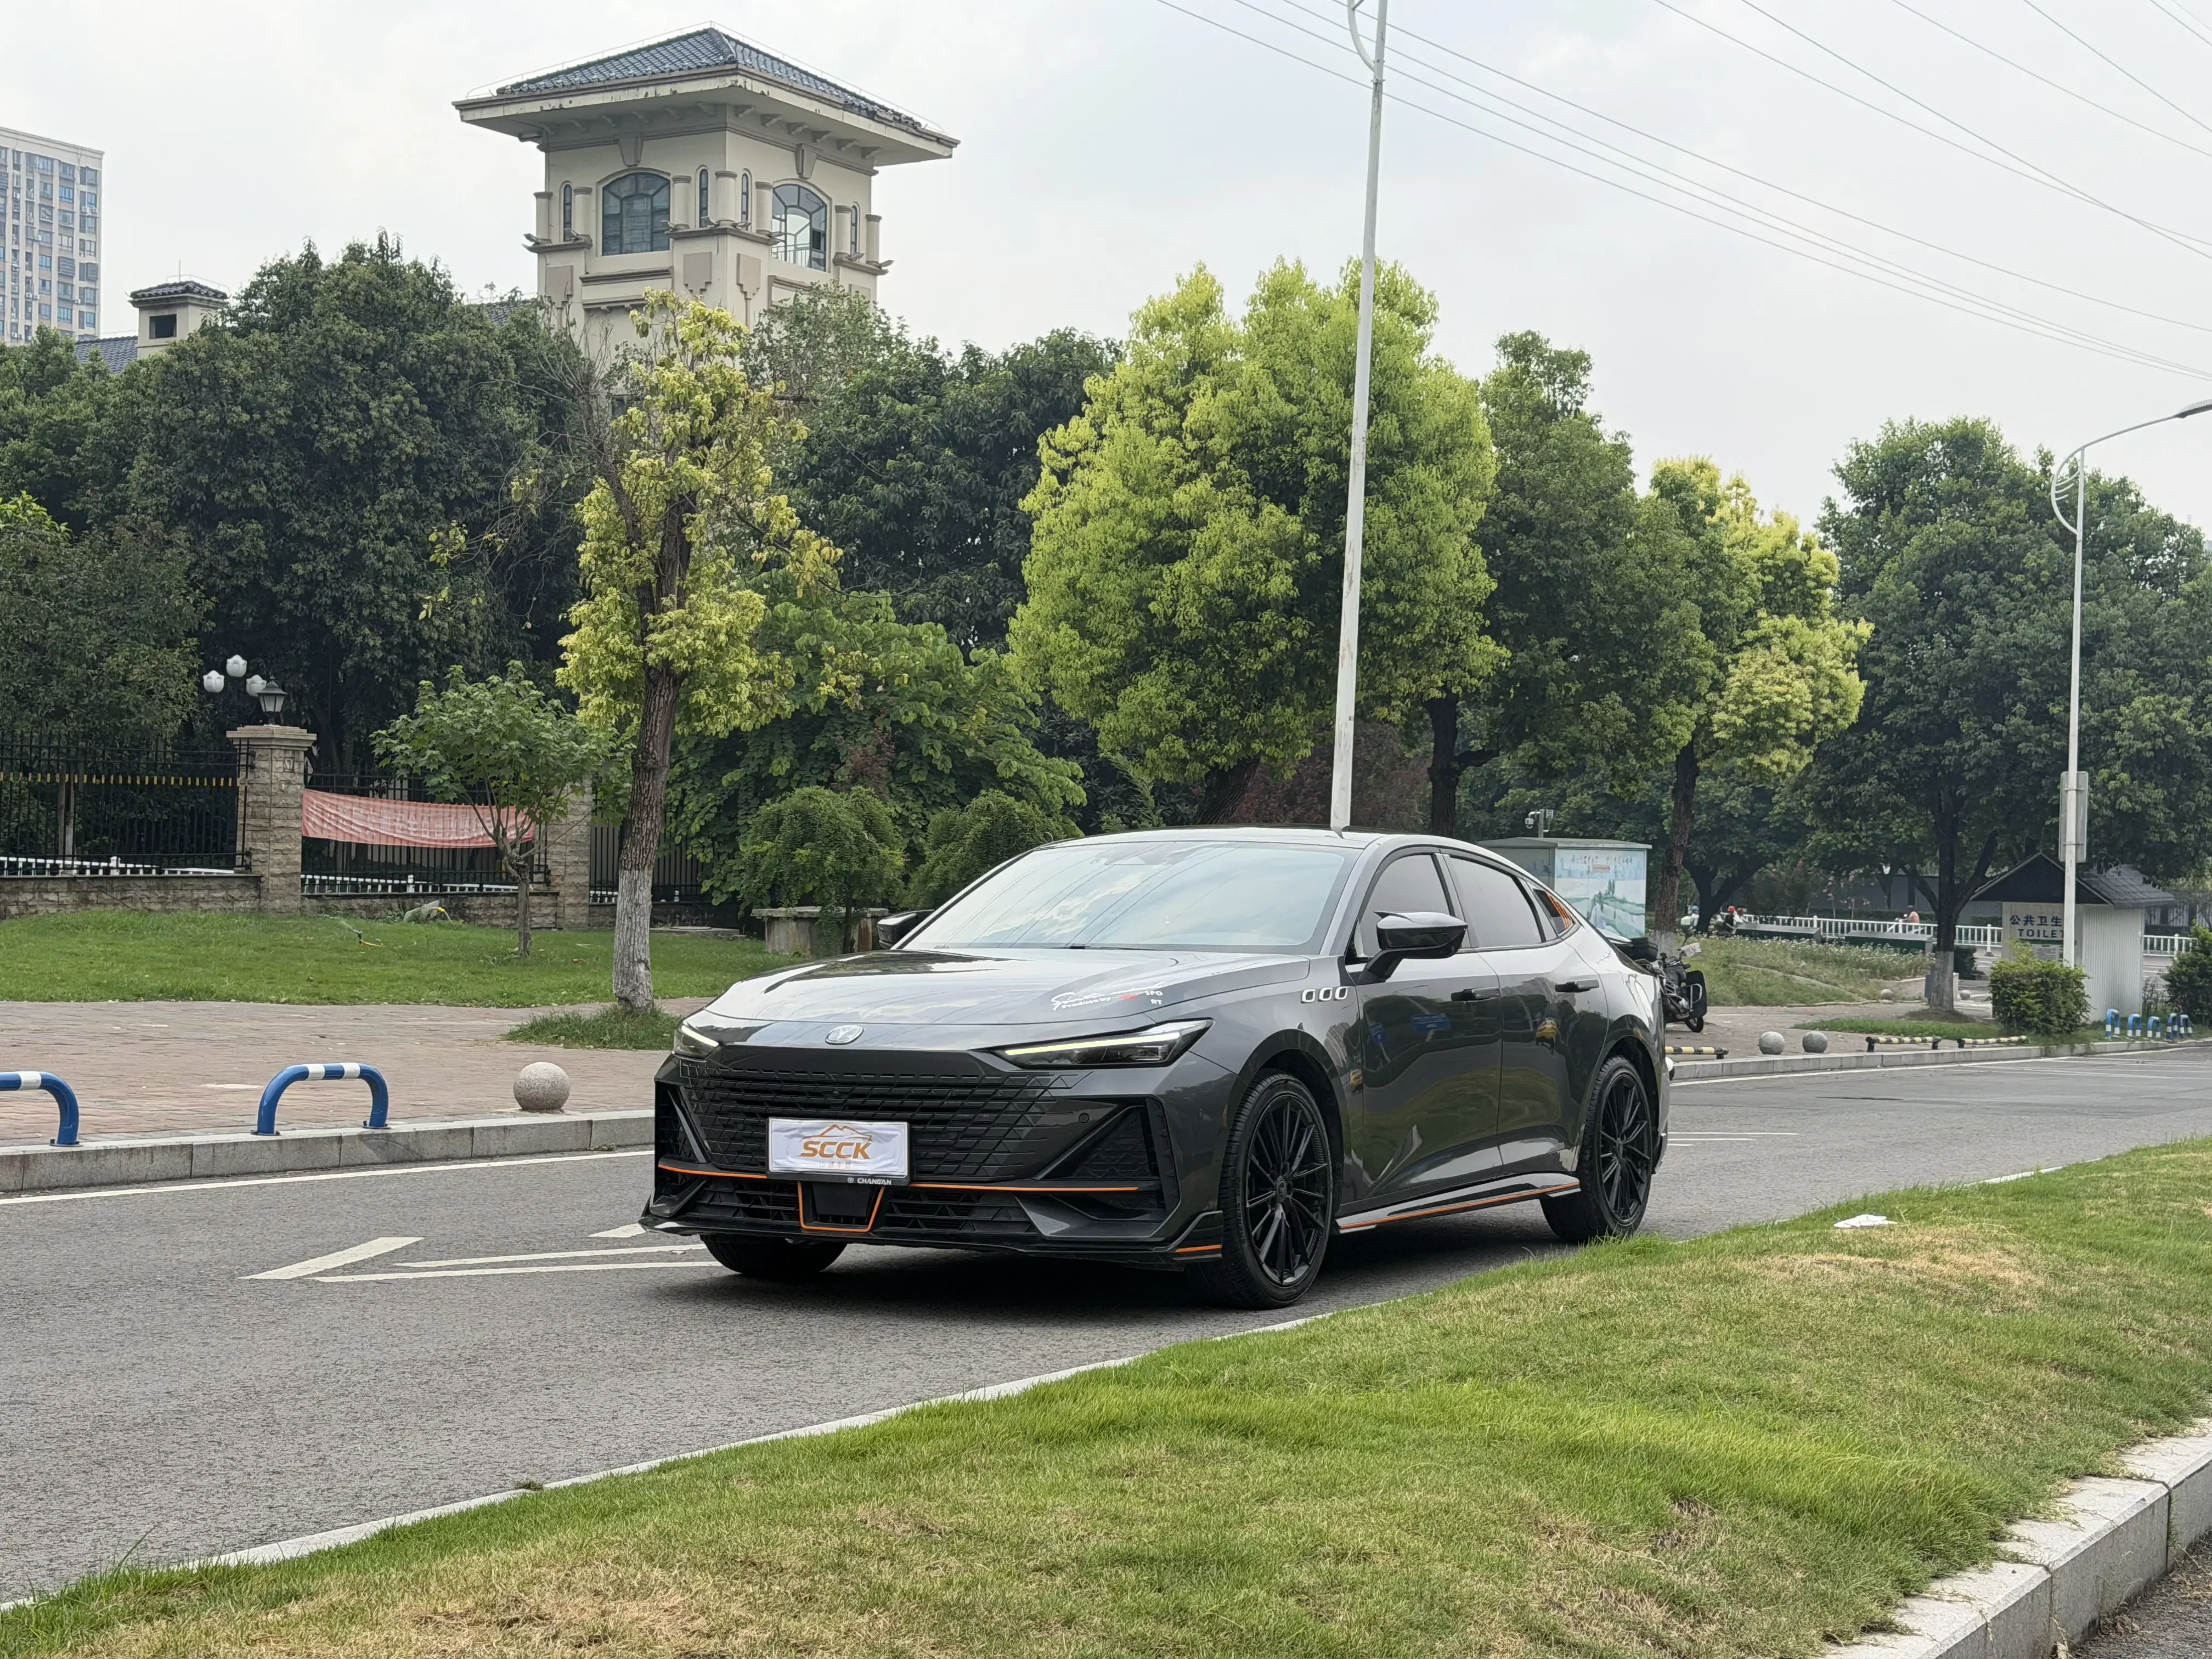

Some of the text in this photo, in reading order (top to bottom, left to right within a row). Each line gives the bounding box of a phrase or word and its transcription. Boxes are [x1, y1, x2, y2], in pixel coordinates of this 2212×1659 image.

[2010, 914, 2063, 927] 公共卫生
[799, 1141, 872, 1159] SCCK
[857, 1177, 891, 1186] CHANGAN
